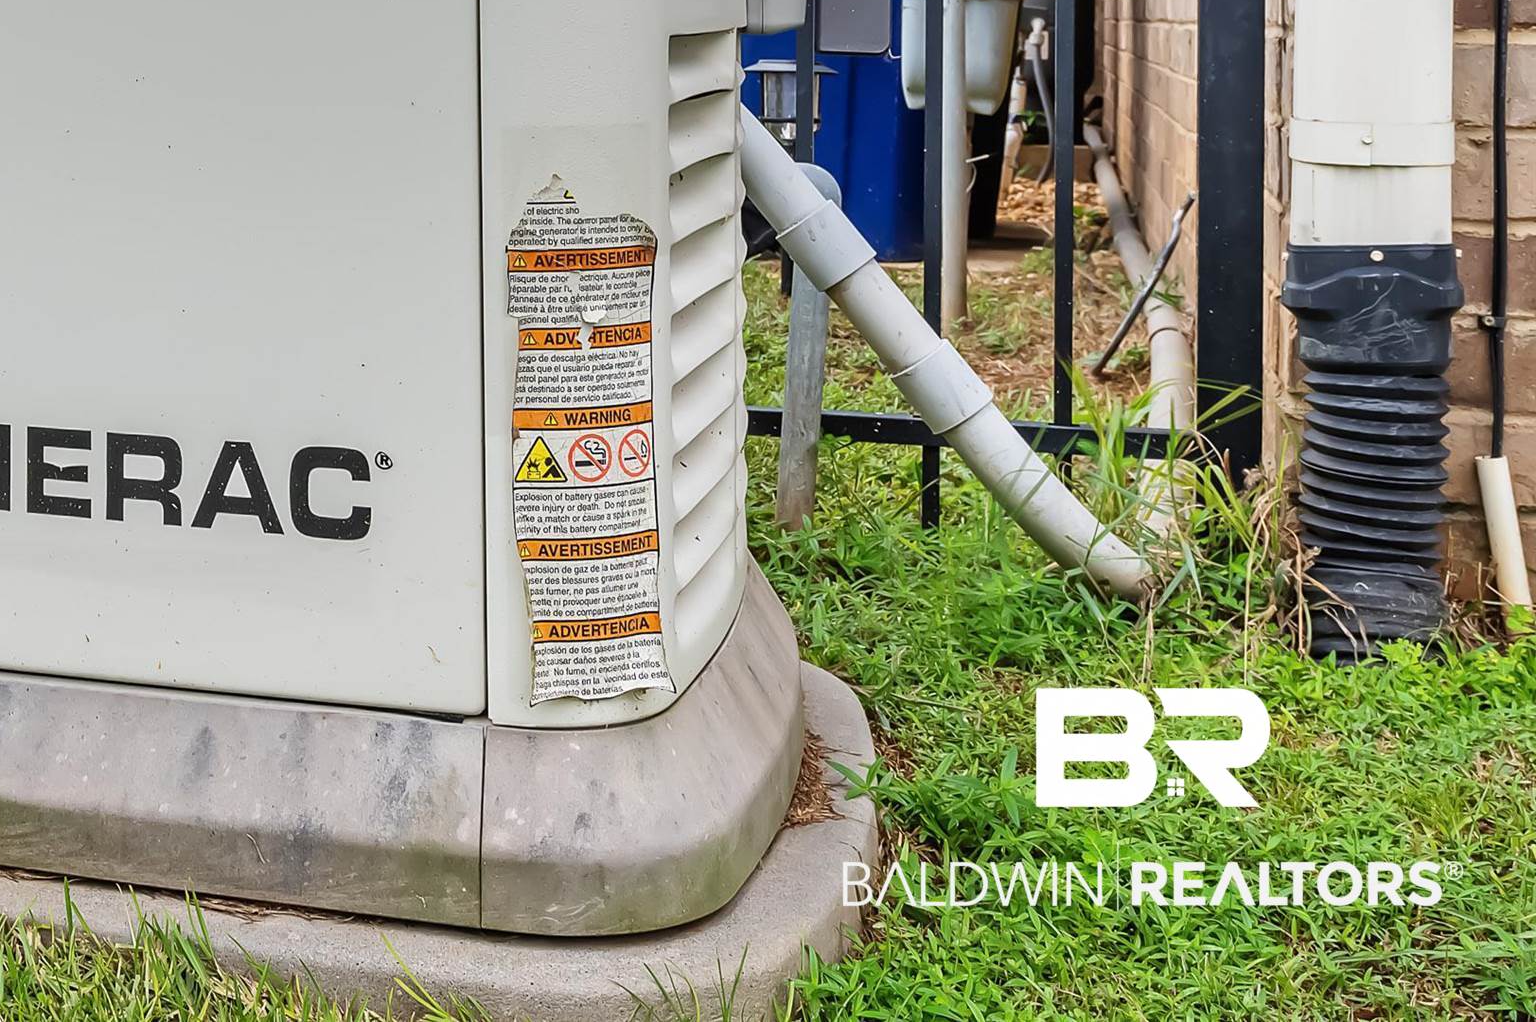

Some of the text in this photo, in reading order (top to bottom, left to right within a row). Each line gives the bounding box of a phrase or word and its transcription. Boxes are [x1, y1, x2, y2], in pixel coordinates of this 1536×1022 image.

[526, 206, 534, 215] of
[536, 206, 564, 215] electric
[557, 217, 571, 225] The
[599, 216, 618, 226] panel
[539, 226, 578, 237] generator
[580, 226, 586, 234] is
[588, 225, 618, 235] intended
[628, 224, 643, 234] only
[508, 238, 546, 247] operated
[548, 237, 558, 246] by
[560, 236, 593, 246] qualified
[595, 236, 619, 244] service
[534, 250, 648, 268] AVERTISSEMENT
[510, 274, 536, 284] Risque
[538, 275, 549, 283] de
[612, 272, 634, 280] Aucune
[614, 280, 638, 290] contrôle
[510, 294, 544, 303] Panneau
[546, 294, 556, 302] de
[570, 293, 610, 304] générateur
[621, 291, 640, 299] moteur
[510, 305, 538, 314] destiné
[540, 305, 546, 313] à
[548, 304, 562, 313] être
[629, 301, 638, 309] par
[538, 354, 548, 362] de
[550, 354, 586, 364] descarga
[536, 366, 552, 374] que
[592, 364, 614, 372] pueda
[615, 360, 636, 370] reparar
[538, 375, 560, 384] panel
[596, 372, 626, 382] generador
[528, 384, 566, 393] destinado
[587, 384, 616, 394] operado
[526, 396, 560, 404] personal
[573, 394, 600, 402] servicio
[564, 408, 631, 426] WARNING
[516, 493, 552, 502] Explosion
[554, 493, 562, 501] of
[564, 493, 592, 502] battery
[594, 491, 616, 501] gases
[542, 504, 564, 514] injury
[577, 503, 600, 512] death.
[604, 501, 615, 509] Do
[616, 499, 626, 508] not
[582, 514, 604, 522] cause
[613, 510, 630, 520] spark
[543, 525, 596, 534] of this battery
[538, 536, 652, 557] AVERTISSEMENT
[574, 566, 588, 575] gaz
[590, 564, 600, 572] de
[602, 564, 608, 572] la
[610, 562, 634, 570] batterie
[562, 576, 599, 584] blessures
[601, 574, 624, 584] graves
[546, 587, 572, 596] fumer,
[586, 587, 600, 596] pas
[601, 584, 626, 594] allumer
[562, 598, 600, 607] provoquer
[548, 617, 650, 638] ADVERTENCIA
[569, 646, 580, 654] de
[594, 644, 616, 654] gases
[618, 642, 626, 650] de
[634, 637, 662, 648] batería
[573, 656, 597, 664] daños
[599, 653, 626, 664] severos
[632, 650, 640, 658] la
[554, 668, 564, 676] No
[566, 667, 588, 676] fume,
[598, 663, 630, 674] encienda
[553, 679, 580, 688] chispas
